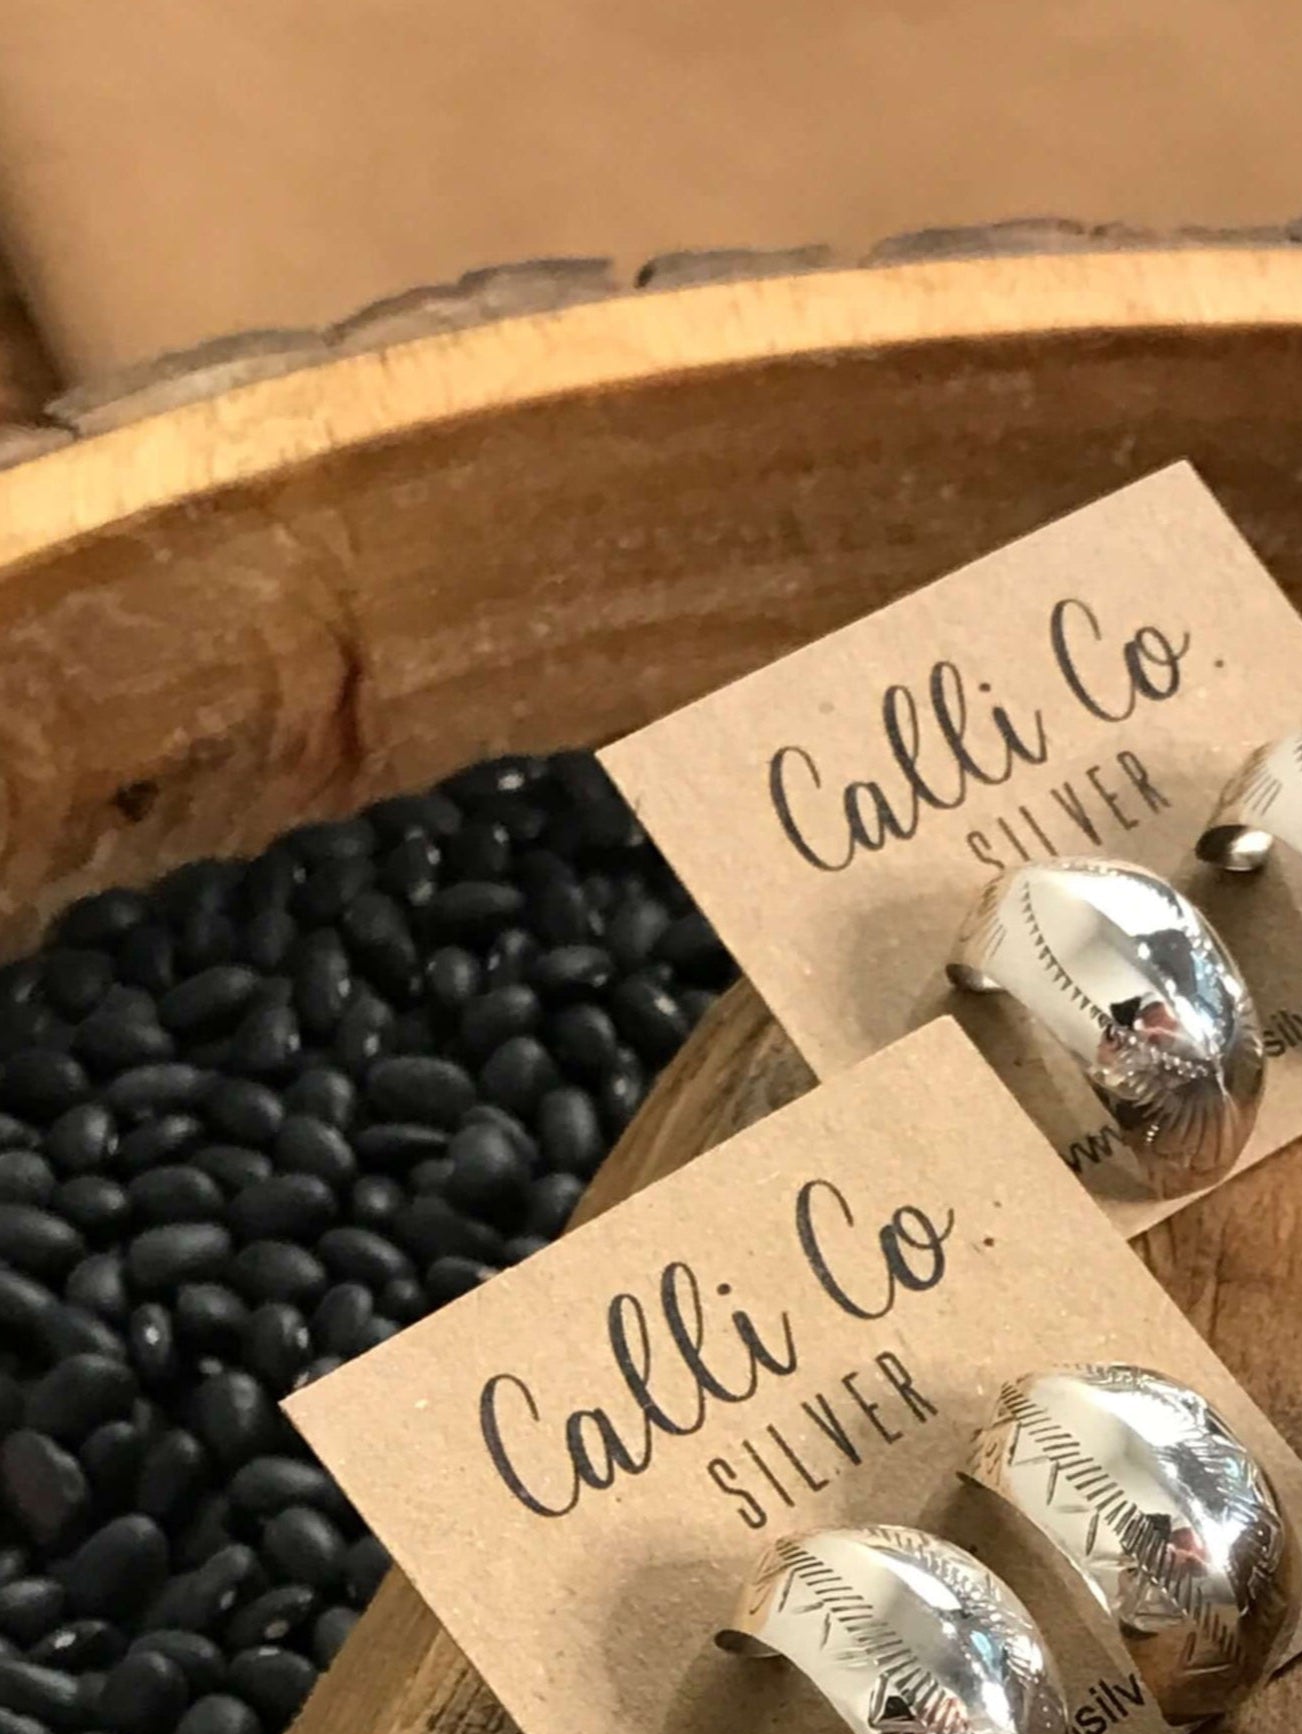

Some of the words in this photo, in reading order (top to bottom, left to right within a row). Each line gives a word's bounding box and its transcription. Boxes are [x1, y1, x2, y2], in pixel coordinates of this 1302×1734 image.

[767, 659, 1048, 872] Calli
[478, 1260, 798, 1519] Calli
[706, 1350, 937, 1530] SILVER
